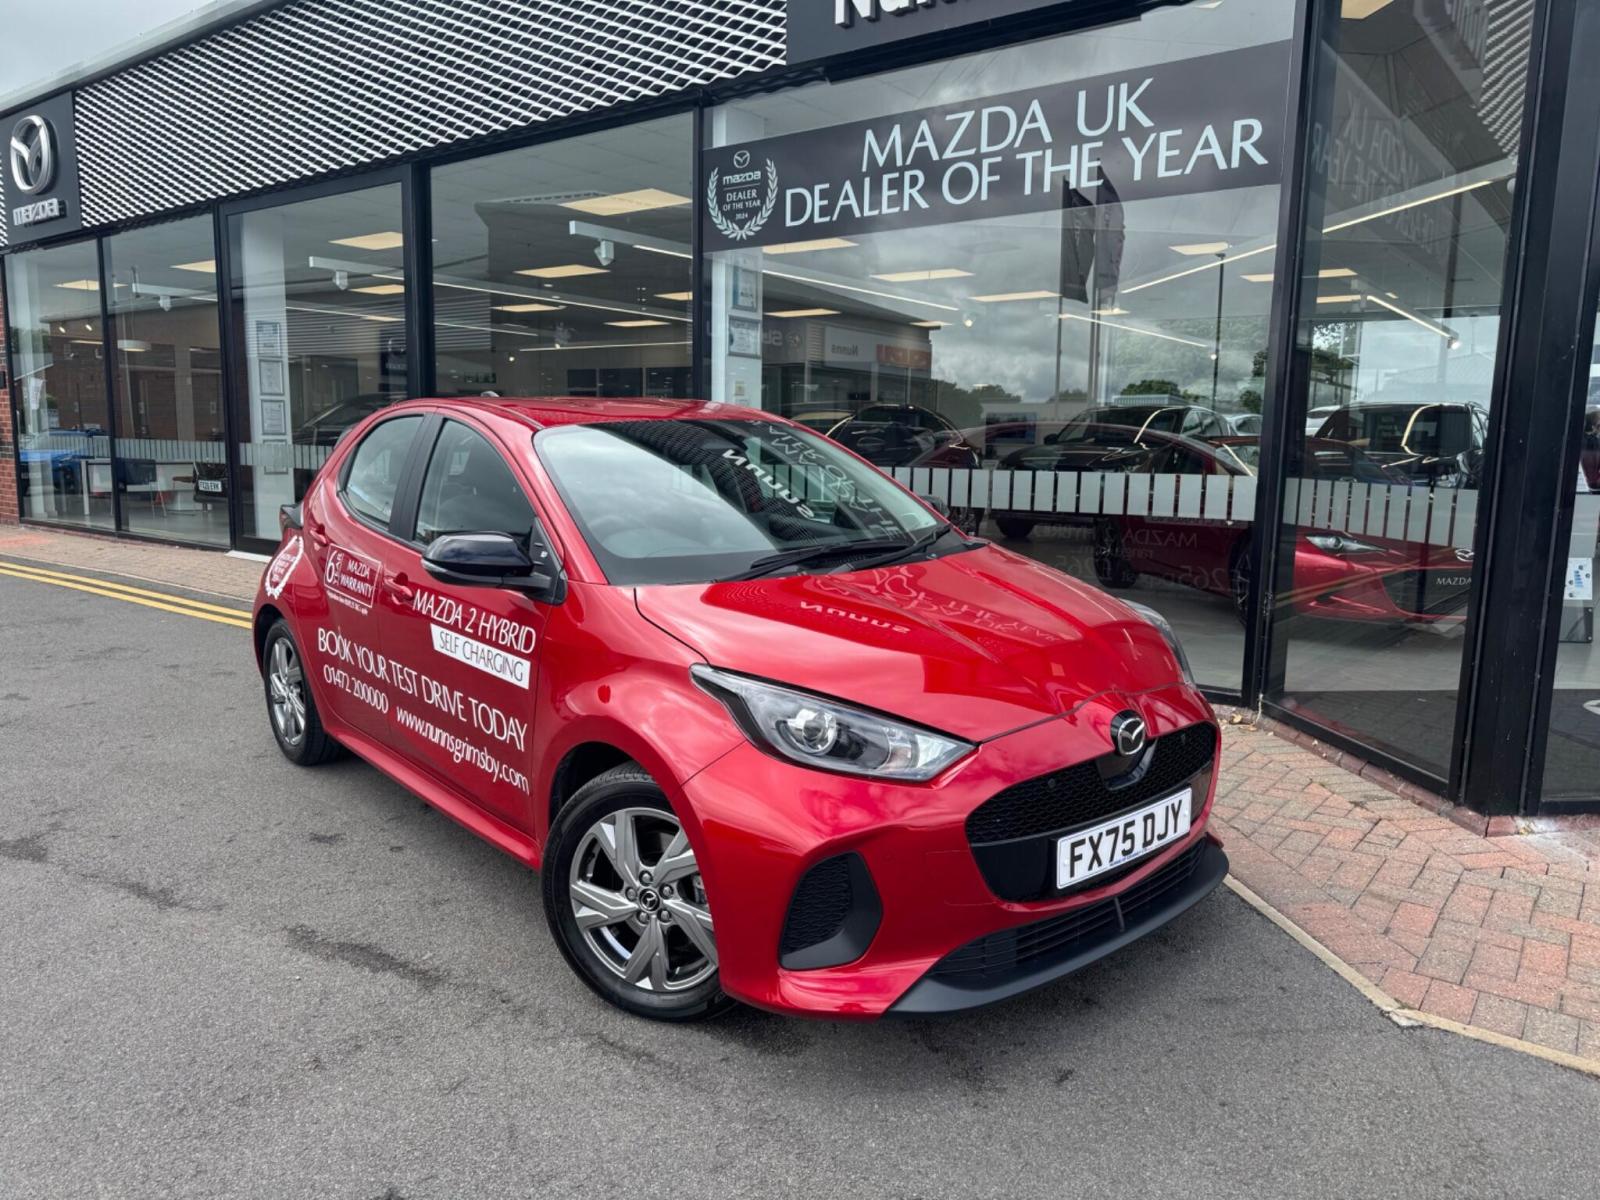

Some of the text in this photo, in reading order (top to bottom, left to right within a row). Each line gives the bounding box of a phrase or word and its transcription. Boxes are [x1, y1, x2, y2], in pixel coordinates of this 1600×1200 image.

[861, 77, 1155, 173] MAZDA UK
[726, 188, 758, 202] DEALER
[785, 118, 1269, 227] DEALER OF THE YEAR
[722, 199, 761, 212] OF THE YEAR
[326, 550, 338, 583] 6
[347, 559, 371, 580] MAZDA
[340, 574, 375, 599] WARRANTY
[1436, 577, 1472, 586] MAZDA
[412, 588, 463, 630] MAZDA
[464, 607, 477, 634] 2
[478, 611, 537, 655] HYBRID
[439, 630, 525, 682] SELF CHARGING
[317, 626, 528, 753] BOOK YOUR TEST DRIVE TODAY
[323, 663, 530, 796] 01472 200000 www.nunnsgrimsby.com
[1069, 819, 1136, 878] FX75
[1141, 799, 1183, 848] DJY
